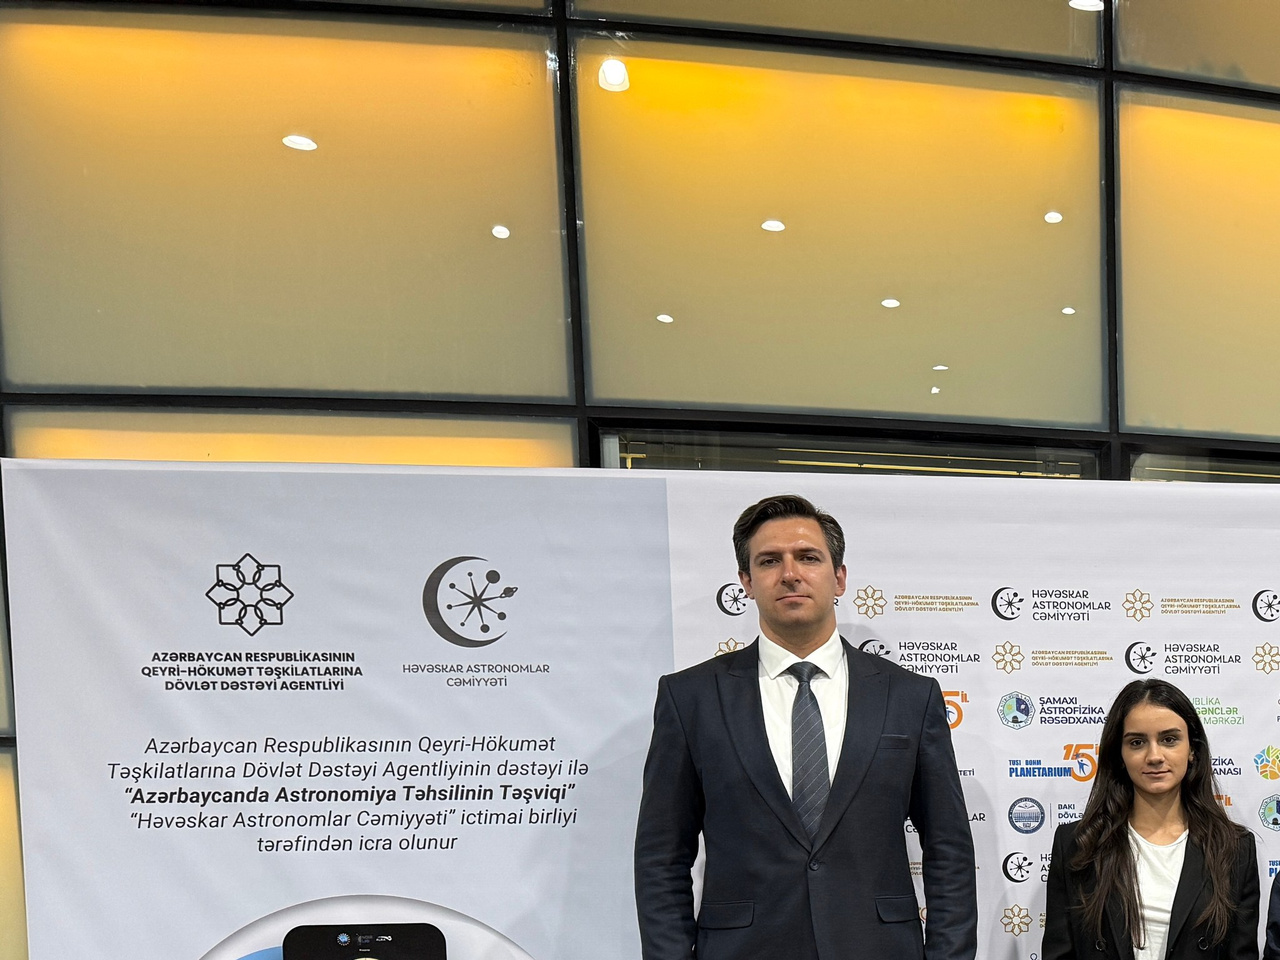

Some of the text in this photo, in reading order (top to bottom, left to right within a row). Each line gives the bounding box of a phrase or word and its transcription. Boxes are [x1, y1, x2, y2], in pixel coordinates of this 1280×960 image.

[1032, 589, 1089, 599] HƏVƏSKAR
[1032, 601, 1111, 611] ASTRONOMLAR
[1032, 610, 1090, 621] CƏMİYYƏTİ
[899, 641, 957, 650] HƏVƏSKAR
[1164, 643, 1220, 653] HƏVƏSKAR
[151, 650, 355, 662] AZƏRBAYCAN RESPUBLİKASININ
[899, 653, 980, 662] ASTRONOMLAR
[1164, 654, 1241, 664] ASTRONOMLAR
[141, 664, 363, 679] QEYRİ-HÖKUMƏT TƏŞKİLATLARINA
[402, 664, 550, 673] HƏVƏSKAR ASTRONOMLAR
[1164, 664, 1220, 674] CƏMİYYƏTİ
[165, 679, 344, 690] DÖVLƏT DƏSTƏYİ AGENTLİYİ
[446, 675, 507, 687] CƏMİYYƏTİ
[1039, 697, 1077, 707] ŞAMAXI
[1040, 705, 1105, 715] ASTROFİZİKA
[1196, 707, 1238, 715] GƏNCLƏR
[1040, 716, 1108, 724] RƏSƏDXANAS
[1203, 715, 1245, 725] MƏRKƏZİ
[144, 735, 556, 758] Azərbaycan Respublikasının Qeyri-Hökumət
[107, 759, 589, 783] Təşkilatlarına Dövlət Dəstəyi Agentliyinin dəstəyi ilə
[1009, 766, 1072, 778] PLANETARIUM
[125, 783, 576, 807] “Azərbaycanda Astronomiya Təhsilinin Təşviqi”
[130, 808, 578, 830] “Həvəskar Astronomlar Cəmiyyəti” ictimai birliyi
[1058, 810, 1083, 819] DÖVLƏ
[257, 834, 458, 852] tərəfindən icra olunur
